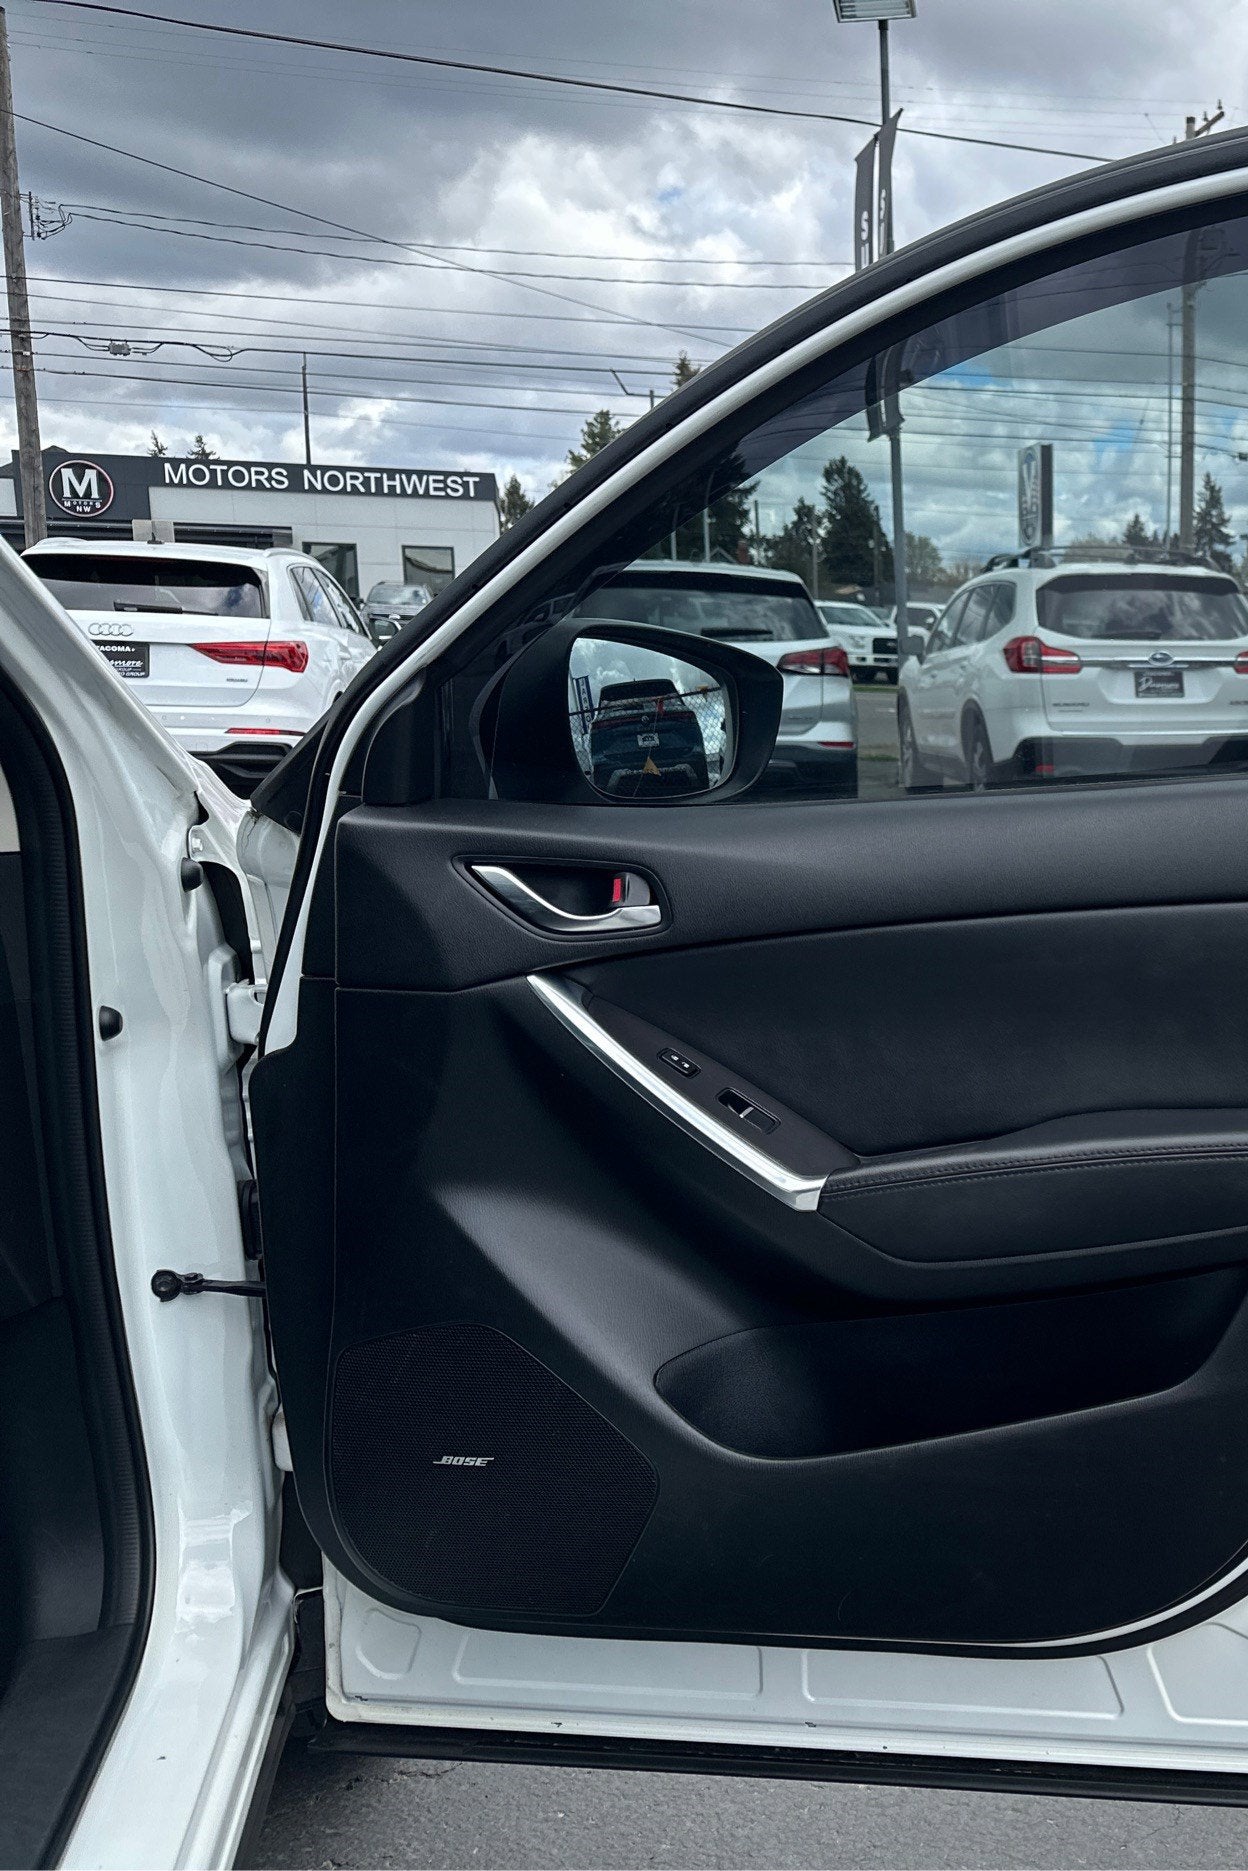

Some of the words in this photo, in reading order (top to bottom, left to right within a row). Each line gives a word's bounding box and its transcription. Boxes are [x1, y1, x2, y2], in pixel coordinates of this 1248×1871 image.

[60, 468, 100, 499] M
[163, 462, 289, 489] MOTORS
[302, 469, 481, 498] NORTHWEST
[433, 1455, 494, 1466] BOSE
